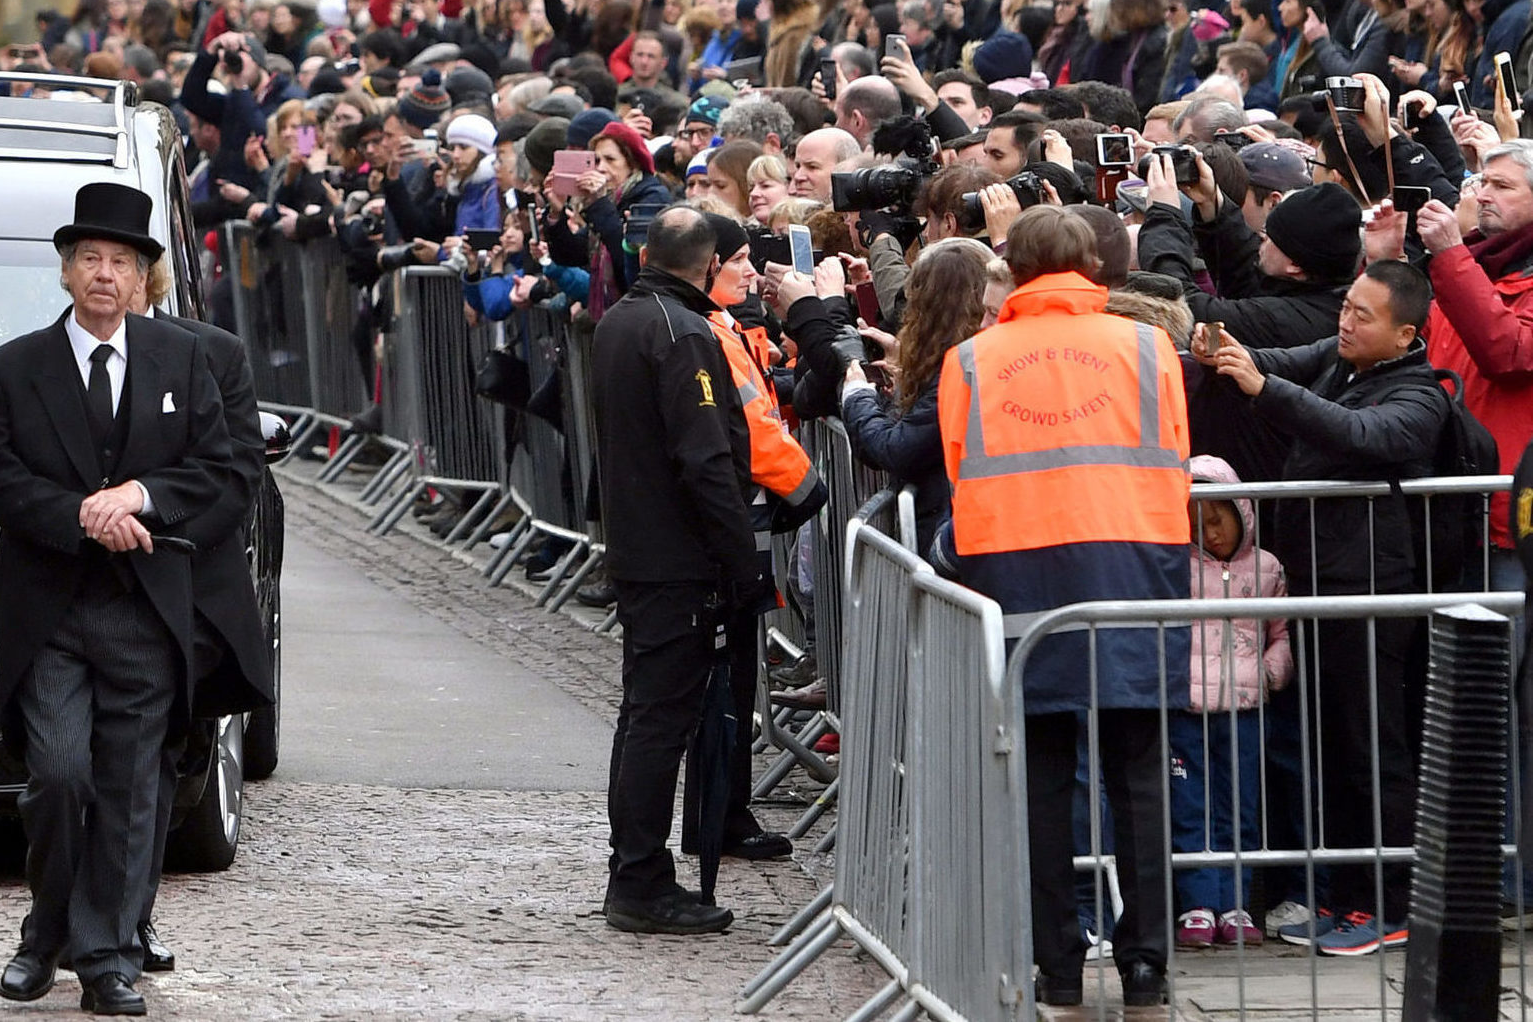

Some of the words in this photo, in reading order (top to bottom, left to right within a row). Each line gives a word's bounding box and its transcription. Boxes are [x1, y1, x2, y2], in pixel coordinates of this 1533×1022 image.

[997, 351, 1039, 382] SHOW
[1046, 348, 1057, 360] &
[1064, 347, 1110, 373] EVENT
[1002, 400, 1058, 426] CROWD
[1062, 389, 1113, 424] SAFETY
